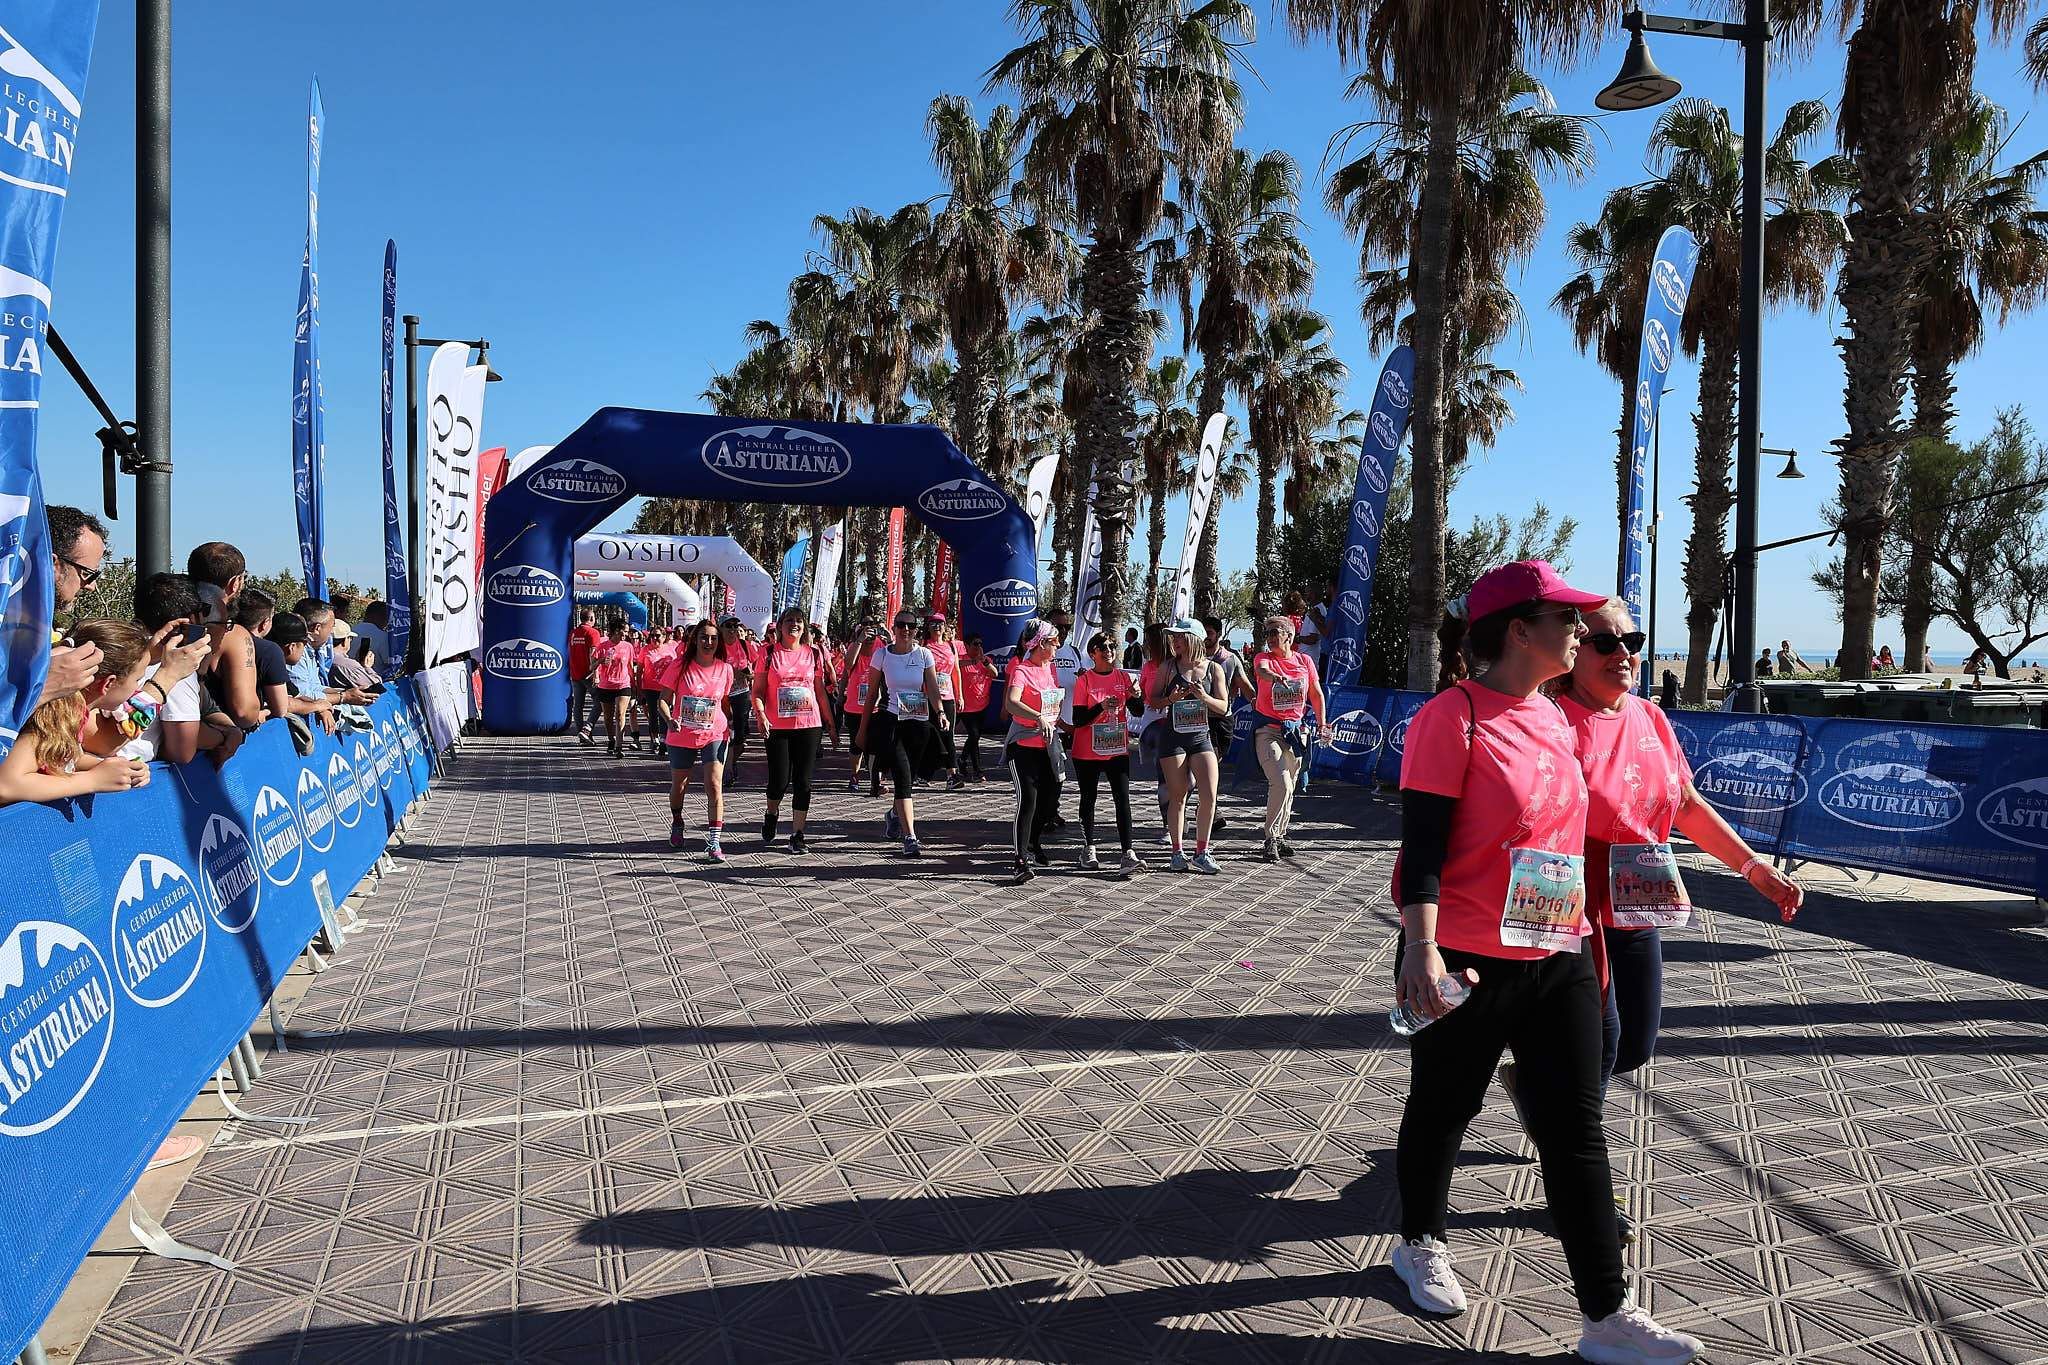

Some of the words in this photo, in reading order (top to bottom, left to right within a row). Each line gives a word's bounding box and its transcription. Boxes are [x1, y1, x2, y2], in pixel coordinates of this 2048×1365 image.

[0, 106, 75, 176] IAN
[713, 441, 841, 473] ASTURIANA
[737, 440, 784, 450] CENTRAL
[789, 444, 836, 453] LECHERA
[533, 473, 619, 494] ASTURIANA
[926, 494, 1001, 510] ASTURIANA
[599, 540, 700, 563] OYSHO
[891, 519, 900, 583] Santander
[491, 580, 560, 597] ASTURIANA
[489, 653, 558, 670] ASTURIANA
[1699, 769, 1796, 801] ASTURIANA
[1827, 783, 1950, 819] ASTURIANA
[258, 823, 301, 870] ASTURIANA
[205, 855, 258, 917] ASTURIANA
[1642, 880, 1676, 894] 016
[130, 904, 162, 933] CENTRAL
[162, 884, 190, 911] LECHERA
[1535, 895, 1563, 913] 016
[121, 901, 203, 990] ASTURIANA
[1, 986, 49, 1034] CENTRAL
[49, 954, 92, 995] LECHERA
